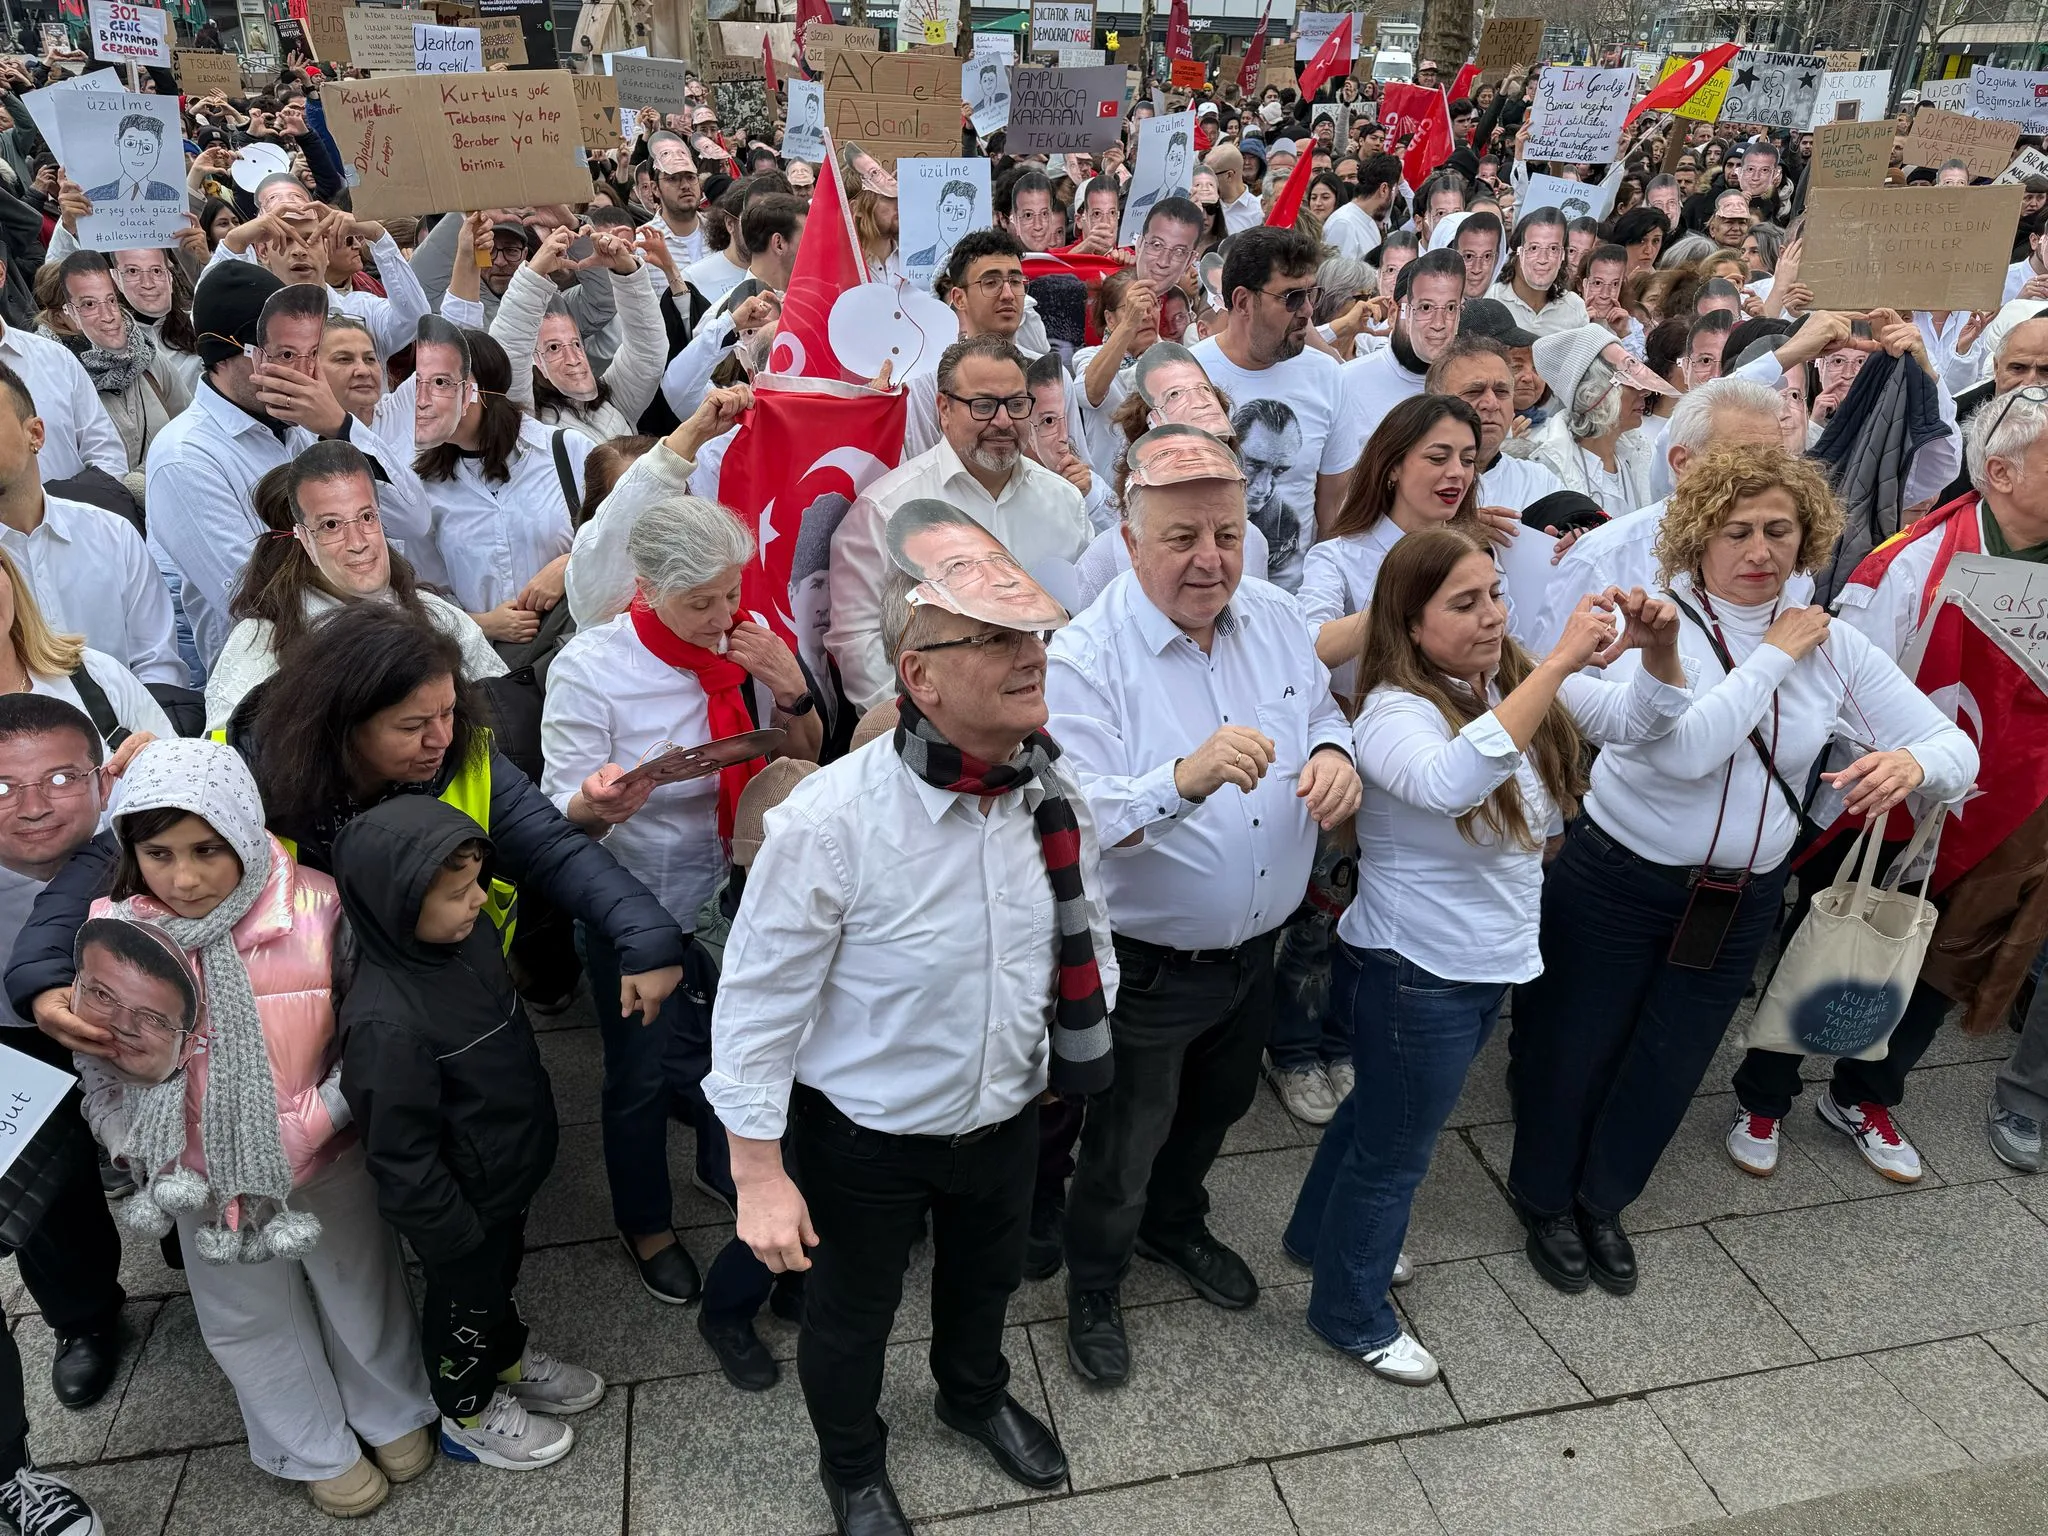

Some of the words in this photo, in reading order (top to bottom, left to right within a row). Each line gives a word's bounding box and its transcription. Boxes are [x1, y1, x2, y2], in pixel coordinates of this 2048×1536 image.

[110, 4, 140, 21] 301
[842, 7, 899, 18] Monald's
[1035, 8, 1068, 21] DICTATOR
[1075, 8, 1092, 22] FALL
[110, 21, 141, 34] GENÇ
[312, 15, 346, 33] PUTS
[99, 30, 158, 47] BAYRAMDA
[413, 27, 474, 52] Uzaktan
[844, 33, 876, 48] KORKAN
[1034, 27, 1074, 43] DEMOCRACY
[1074, 28, 1091, 43] RISE
[485, 48, 509, 60] BACK
[417, 53, 432, 72] da
[616, 62, 644, 75] DARP
[827, 52, 884, 94] AY
[895, 60, 950, 101] Tek
[1018, 71, 1069, 90] AMPUL
[1539, 67, 1555, 97] Ey
[1562, 70, 1584, 92] Türk
[1852, 75, 1877, 89] ODER
[2023, 78, 2036, 90] Ve
[440, 83, 518, 104] Kurtuluş
[527, 82, 550, 100] yok
[88, 95, 153, 111] üzülme
[1545, 96, 1574, 112] Birinci
[444, 111, 507, 126] Tekbaşına
[538, 106, 561, 125] hep
[1011, 108, 1084, 126] KARARAN
[1543, 113, 1562, 127] Türk
[1747, 107, 1793, 126] ACAB
[1155, 117, 1185, 134] üzülme
[1541, 126, 1558, 137] Türk
[452, 132, 500, 150] Beraber
[542, 128, 560, 145] hiç
[1027, 132, 1053, 148] TEK
[1057, 131, 1092, 148] ÜLKE
[1823, 128, 1842, 144] EU
[1847, 125, 1871, 141] HÖR
[1874, 126, 1893, 139] AUF
[1821, 144, 1863, 159] HINTER
[1917, 140, 1940, 151] VUR
[460, 157, 506, 172] birimiz
[920, 161, 970, 178] üzülme
[1834, 167, 1872, 178] STEHEN!
[1548, 181, 1590, 198] üzülme
[109, 206, 124, 219] şey
[130, 203, 146, 217] çok
[152, 204, 182, 219] güzel
[1839, 201, 1960, 220] GIDERLERSE
[120, 219, 156, 227] olacak
[1943, 219, 1992, 233] DEDIN
[1885, 238, 1962, 253] GITTILER
[908, 269, 924, 279] Her
[1895, 260, 1935, 274] SIRA
[1942, 260, 1995, 274] SENDE
[1960, 567, 2048, 620] Taks
[1841, 990, 1887, 1010] KULTR
[1825, 1000, 1889, 1020] AKADEMIE
[1821, 1026, 1871, 1041] KÜLTÜR
